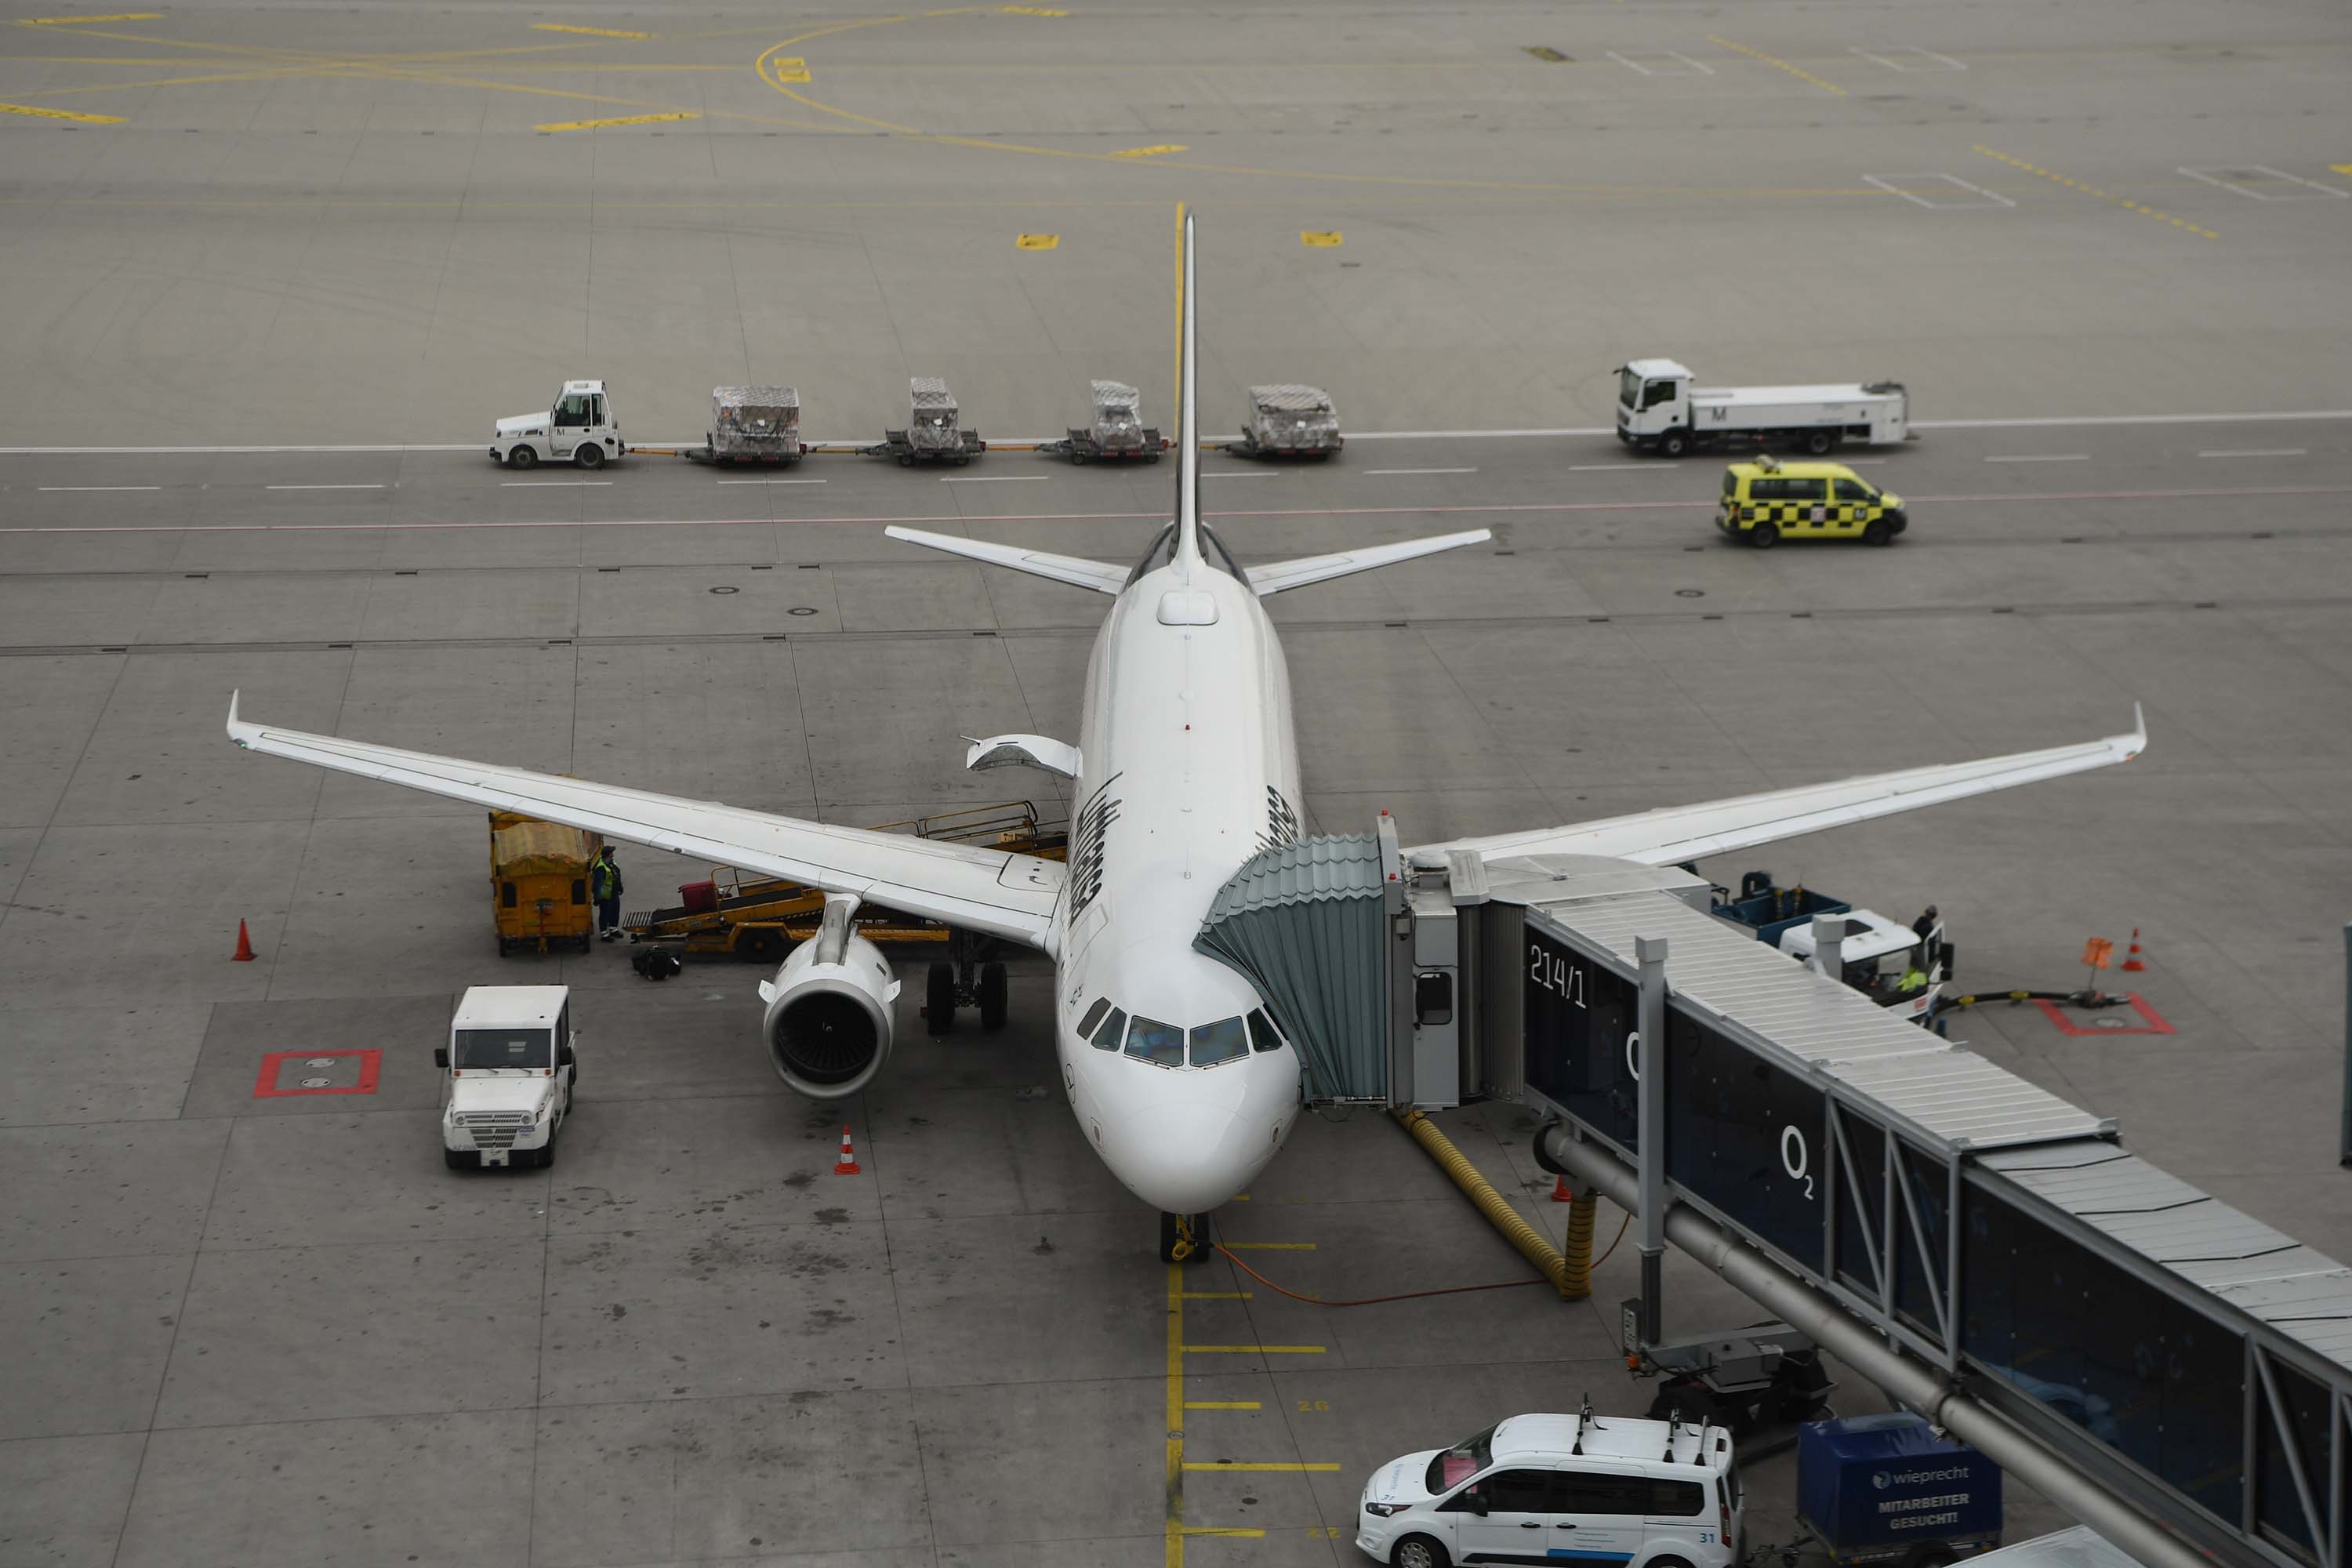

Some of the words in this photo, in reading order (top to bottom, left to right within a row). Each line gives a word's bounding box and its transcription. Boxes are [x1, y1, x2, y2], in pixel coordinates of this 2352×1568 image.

[1530, 944, 1587, 1009] 214/1
[1893, 1465, 1970, 1485] wieprecht
[1878, 1493, 1970, 1514] MITARBEITER
[1889, 1512, 1958, 1530] GESUCHT!
[1699, 1533, 1715, 1544] 31
